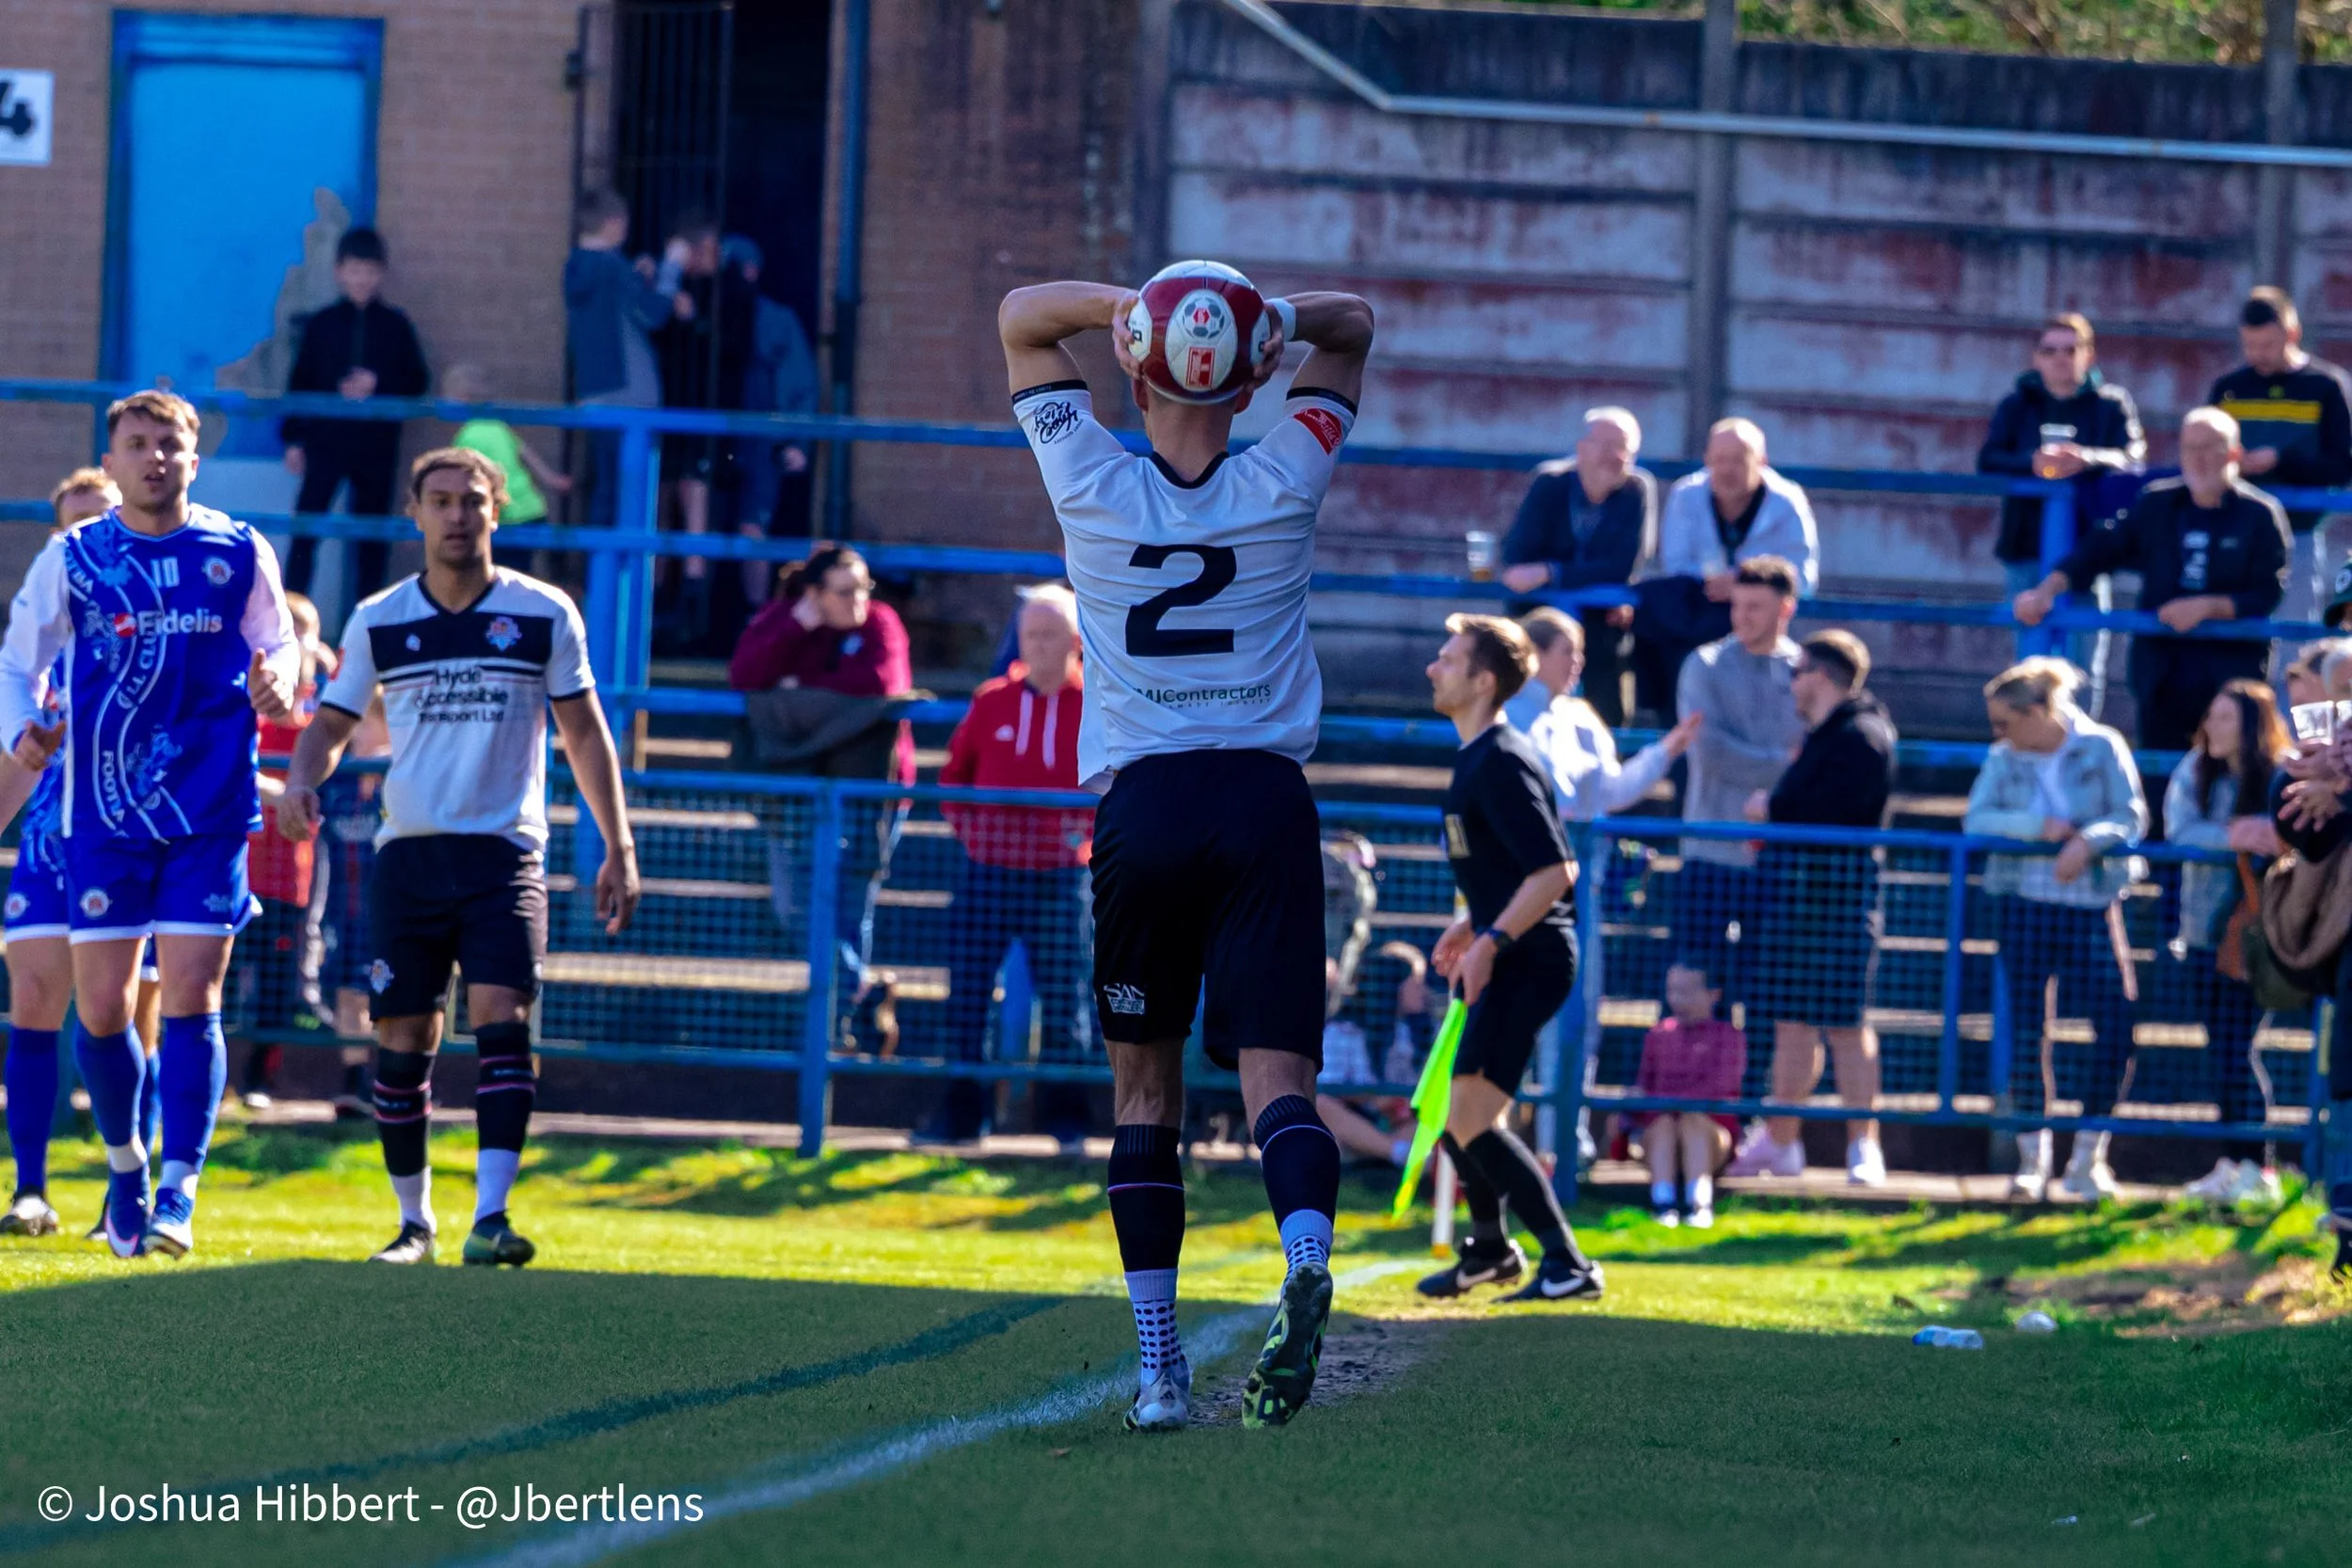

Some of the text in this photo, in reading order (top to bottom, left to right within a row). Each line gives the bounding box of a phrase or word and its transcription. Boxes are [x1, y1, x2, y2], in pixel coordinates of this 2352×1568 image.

[151, 556, 180, 588] 10
[1125, 544, 1237, 657] 2
[137, 607, 223, 636] Fidelis
[435, 668, 482, 691] Hyde
